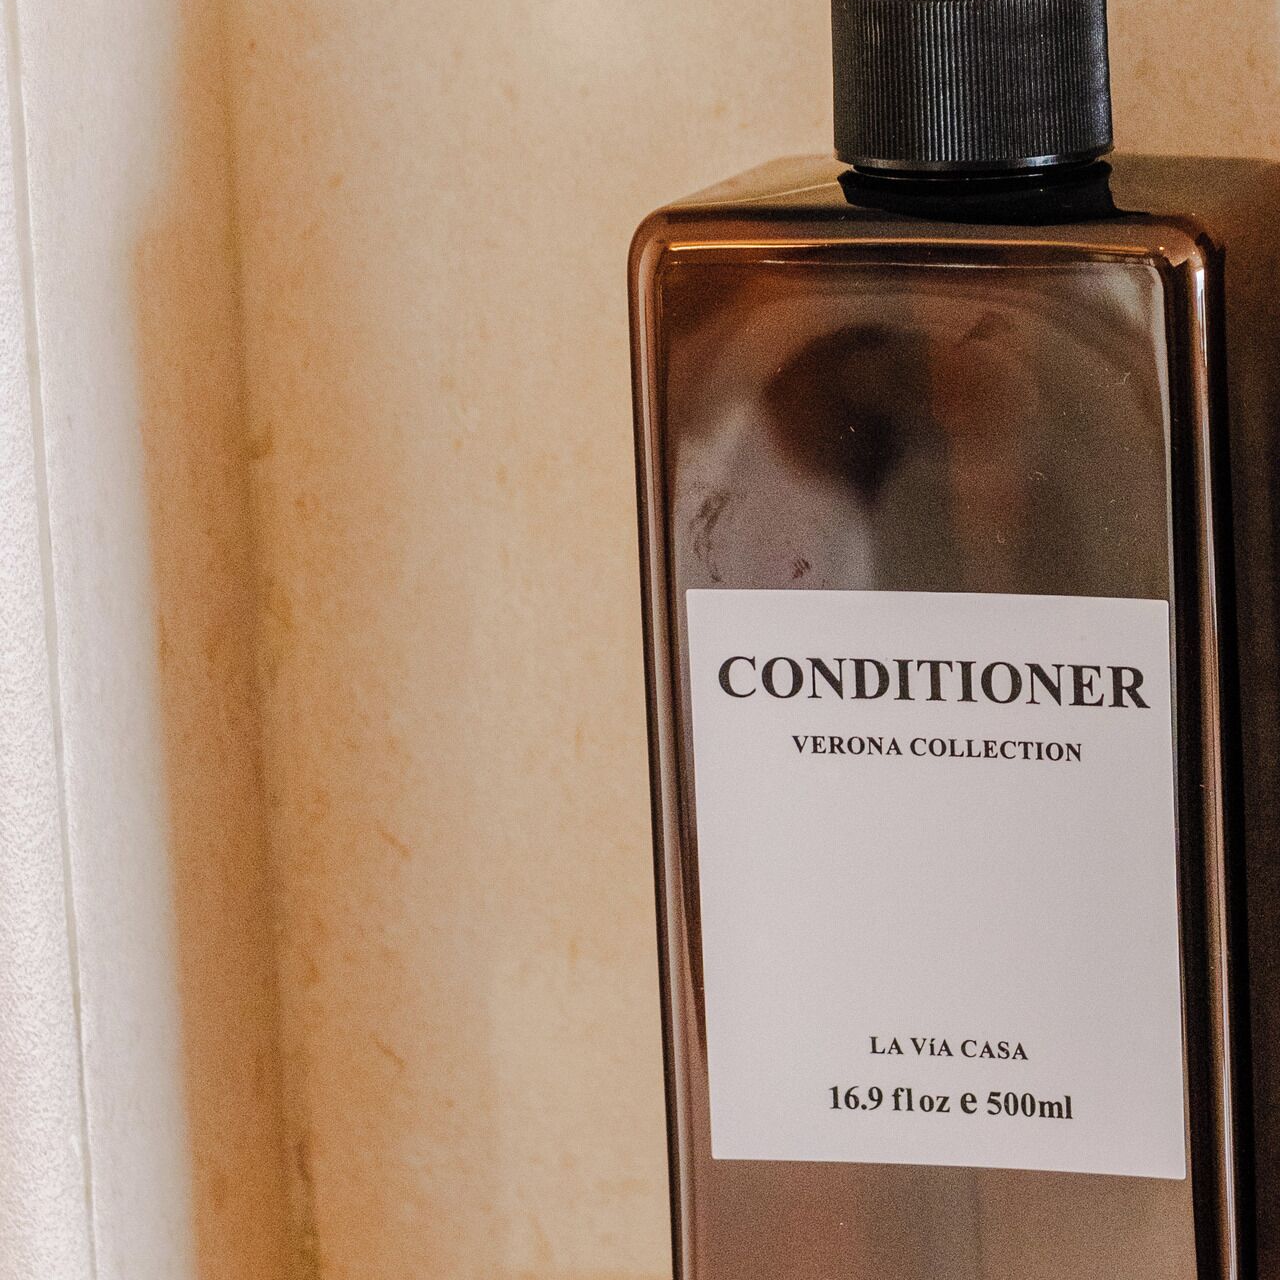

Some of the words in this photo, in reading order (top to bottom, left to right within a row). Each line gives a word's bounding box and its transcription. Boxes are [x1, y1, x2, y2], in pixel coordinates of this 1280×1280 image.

[718, 656, 1152, 709] CONDITIONER
[791, 735, 903, 756] VERONA
[909, 737, 1082, 762] COLLECTION
[870, 1036, 904, 1055] LA
[960, 1039, 1029, 1061] CASA
[829, 1085, 884, 1111] 16.9
[960, 1092, 978, 1115] e
[986, 1091, 1073, 1120] 500ml
